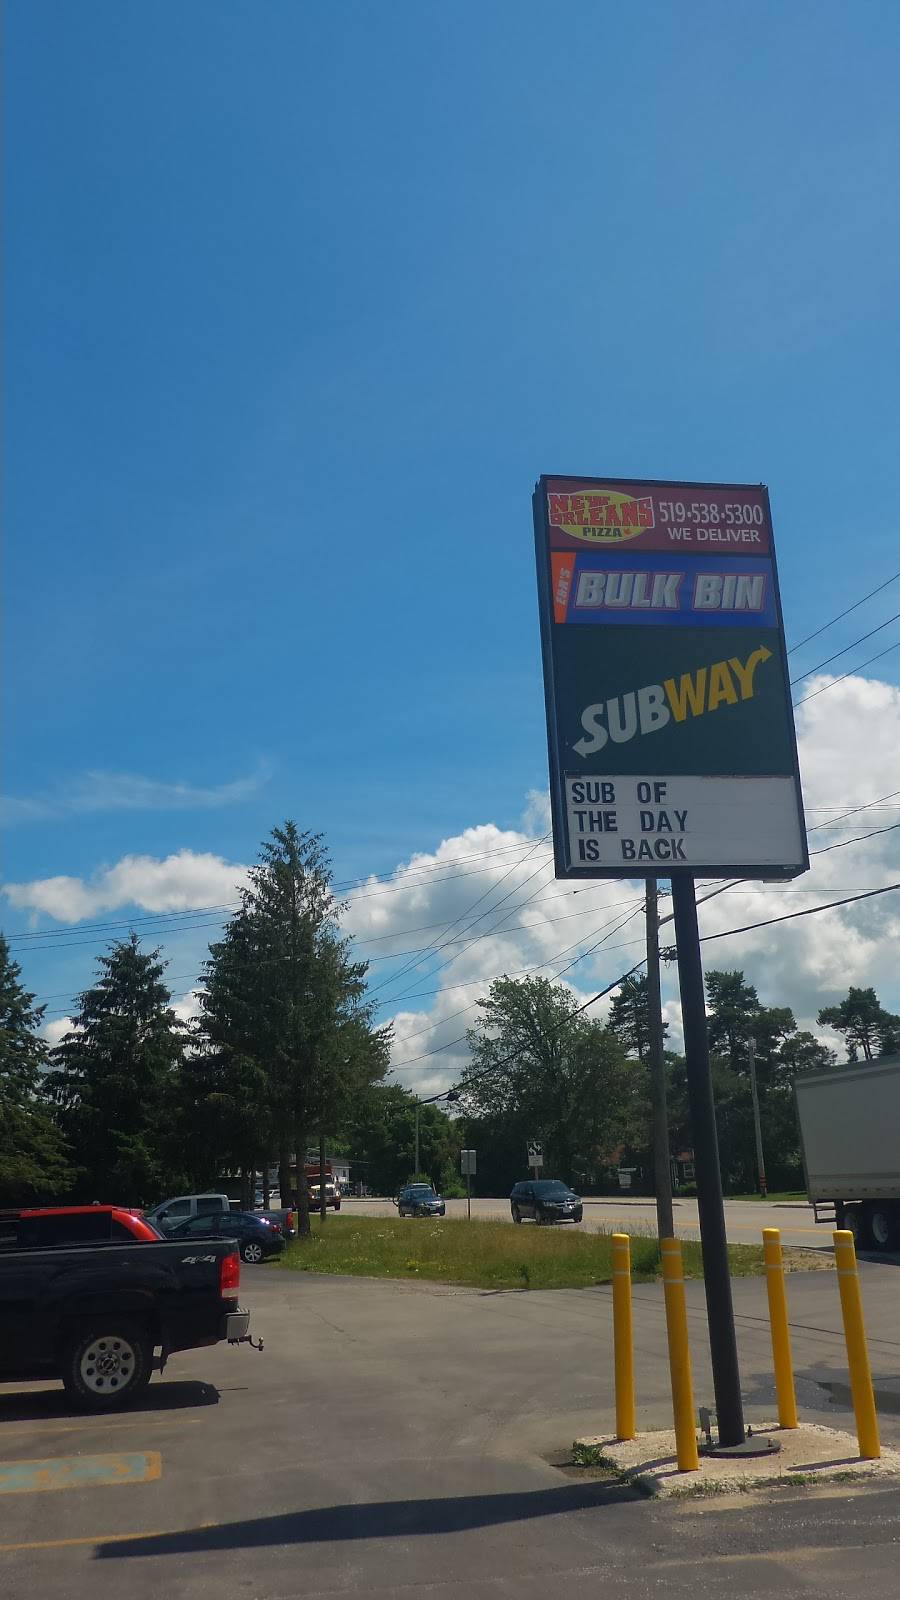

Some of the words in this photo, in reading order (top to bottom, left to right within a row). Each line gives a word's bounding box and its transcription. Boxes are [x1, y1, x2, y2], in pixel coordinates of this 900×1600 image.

[549, 495, 610, 513] NEW
[550, 498, 653, 527] ORLEANS
[582, 527, 622, 538] PIZZA
[667, 527, 692, 541] WE
[696, 528, 761, 543] DELIVER
[575, 571, 683, 609] BULK
[693, 573, 765, 611] BIN
[572, 645, 773, 758] SUBWAY
[571, 782, 616, 804] SUB
[636, 782, 667, 803] OF
[574, 810, 618, 832] THE
[640, 810, 688, 832] DAY
[578, 839, 600, 861] IS
[621, 839, 687, 861] BACK
